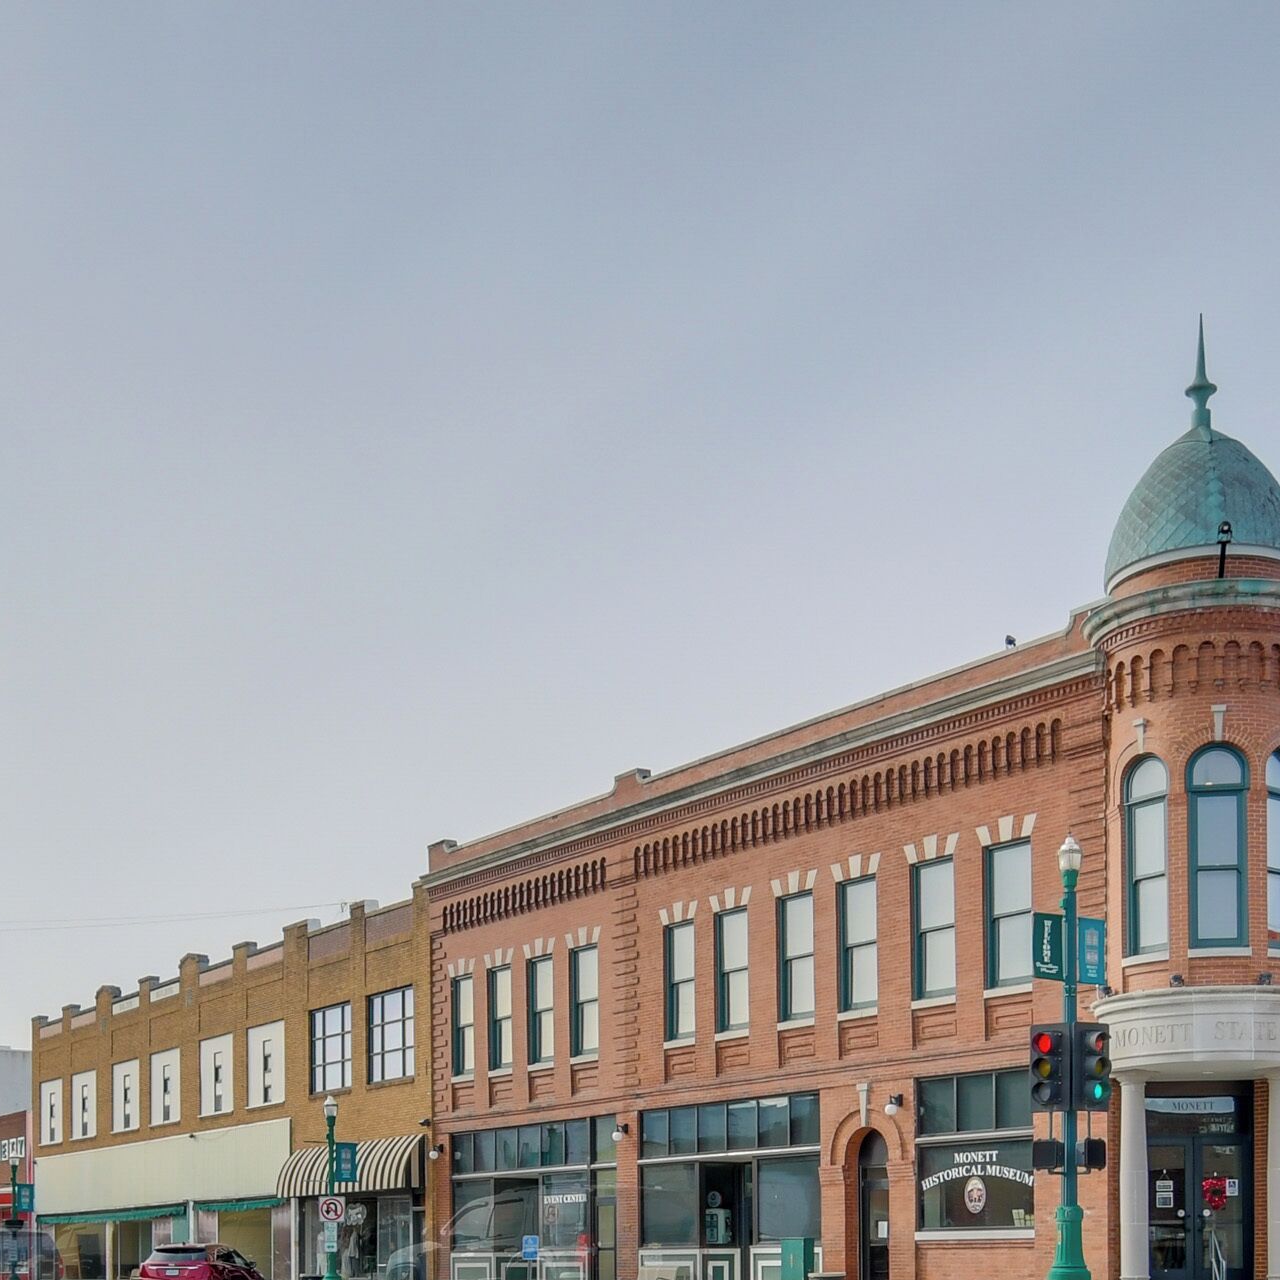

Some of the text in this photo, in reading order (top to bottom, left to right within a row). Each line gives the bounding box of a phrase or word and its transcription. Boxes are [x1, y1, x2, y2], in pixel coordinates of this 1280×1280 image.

[1115, 1023, 1193, 1049] MONETT
[1172, 1101, 1214, 1111] MONETT
[954, 1150, 999, 1164] MONETT
[921, 1164, 1035, 1191] HISTORICAL MUSEUM
[543, 1193, 587, 1204] EVENT CENTER
